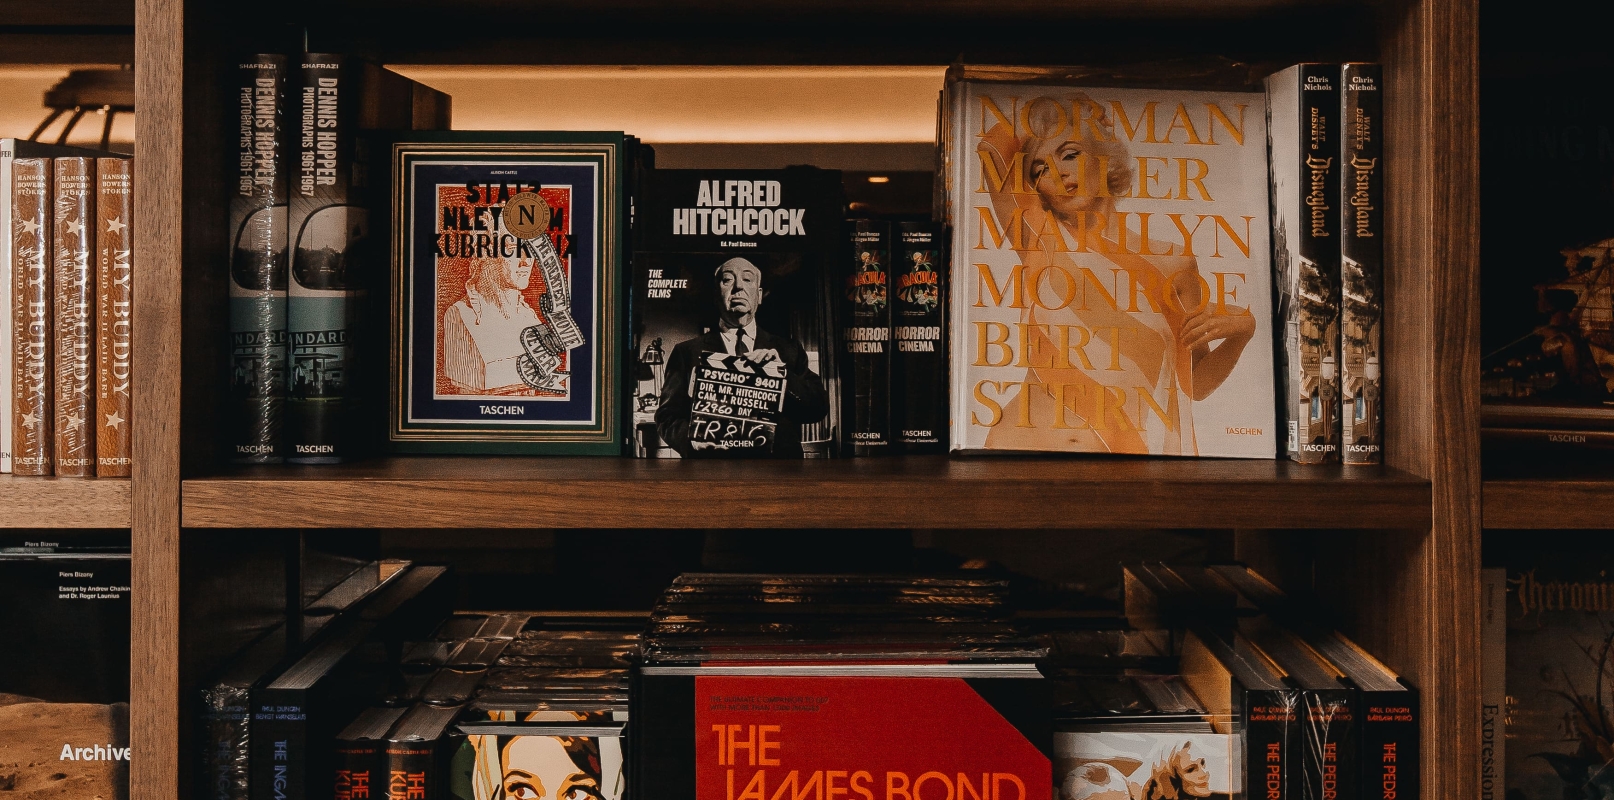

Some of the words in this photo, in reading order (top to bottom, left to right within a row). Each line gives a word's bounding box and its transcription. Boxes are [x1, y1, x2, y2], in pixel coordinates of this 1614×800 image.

[1352, 76, 1374, 84] Chris
[255, 78, 276, 128] DENNIS
[318, 77, 338, 128] DENNIS
[240, 87, 253, 148] PHOTOGRAPHS
[302, 87, 315, 148] PHOTOGRAPHS
[976, 95, 1249, 146] NORMAN
[1311, 107, 1319, 150] DISNEY'S
[254, 132, 275, 186] HOPPER
[316, 132, 338, 186] HOPPER
[240, 151, 253, 197] 1961-1967
[301, 151, 315, 197] 1961-1967
[974, 150, 1215, 202] MAILER
[697, 180, 781, 207] ALFRED
[1305, 153, 1333, 238] Disneyland
[1350, 153, 1378, 238] Disneyland
[517, 204, 536, 226] N
[673, 208, 806, 236] HITCHCOCK
[972, 206, 1256, 259] MARILYN
[29, 249, 46, 290] MY
[73, 250, 90, 290] MY
[113, 248, 131, 290] MY
[648, 269, 663, 279] THE
[647, 279, 687, 289] COMPLETE
[647, 289, 672, 298] FILMS
[972, 263, 1250, 317] MONROE
[551, 310, 582, 347] MOVIE
[843, 327, 889, 341] HORROR
[894, 326, 941, 340] HORROR
[29, 300, 46, 399] BUDDY
[73, 300, 90, 399] BUDDY
[113, 301, 131, 399] BUDDY
[526, 329, 557, 371] NEVER
[847, 342, 884, 353] CINEMA
[898, 341, 935, 352] CINEMA
[971, 321, 1138, 372] BERT
[699, 382, 716, 393] DIR.
[718, 385, 734, 397] MR.
[735, 388, 778, 402] HITCHCOCK
[755, 376, 780, 390] 9401
[479, 405, 524, 415] TASCHEN
[697, 391, 717, 402] CAM.
[720, 395, 728, 404] J.
[730, 396, 769, 411] RUSSELL
[737, 407, 753, 417] DAY
[971, 379, 1180, 433] STERN
[720, 440, 754, 448] TASCHEN
[1225, 427, 1262, 436] TASCHEN
[1548, 434, 1586, 443] TASCHEN
[15, 457, 50, 465] TASCHEN
[99, 457, 132, 465] TASCHEN
[236, 445, 273, 454] TASCHEN
[295, 445, 333, 454] TASCHEN
[1301, 444, 1336, 452] TASCHEN
[60, 458, 94, 466] TASCHEN
[74, 571, 93, 579] Bizony
[80, 586, 87, 594] by
[274, 740, 288, 760] THE
[712, 724, 781, 766] THE
[1267, 742, 1280, 763] THE
[1323, 742, 1337, 763] THE
[1383, 742, 1397, 763] THE
[351, 770, 369, 798] THE
[407, 771, 425, 799] THE
[886, 770, 1026, 800] BOND
